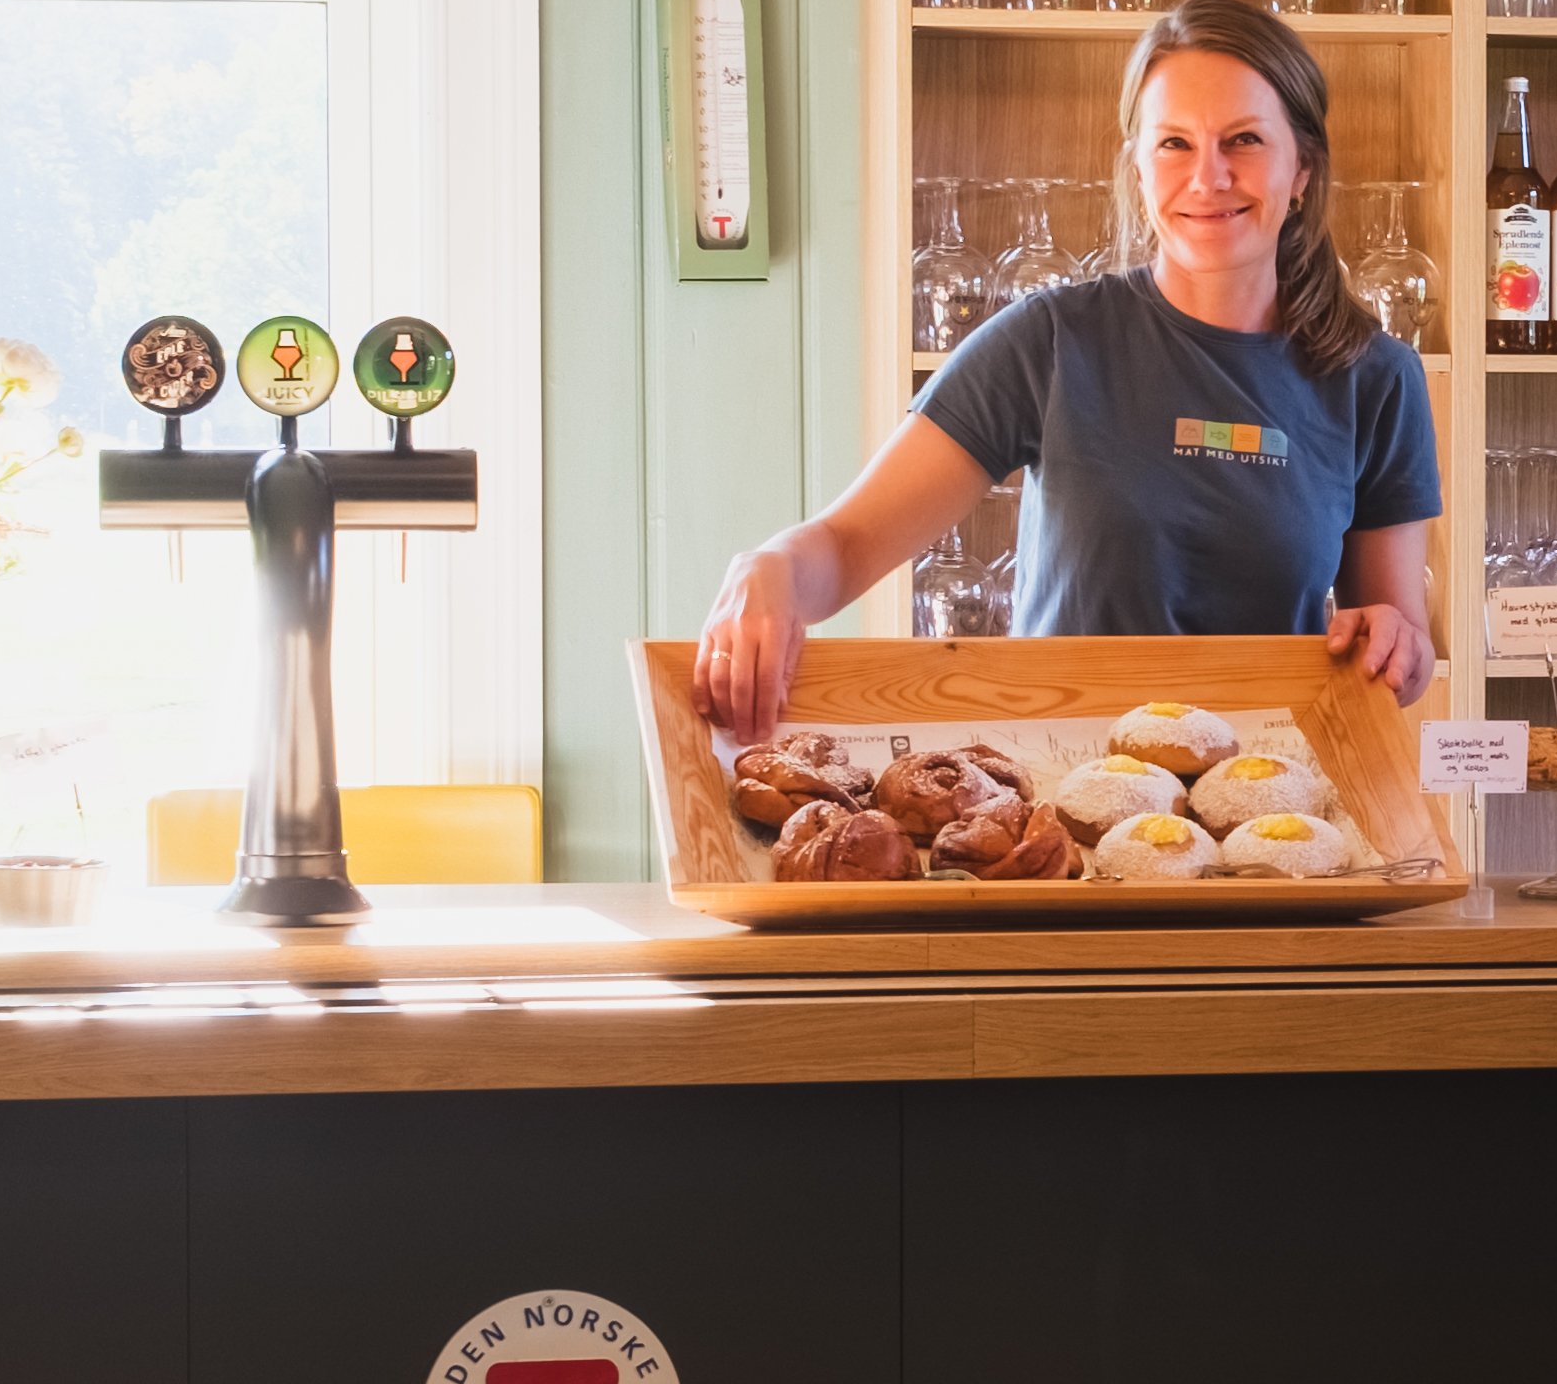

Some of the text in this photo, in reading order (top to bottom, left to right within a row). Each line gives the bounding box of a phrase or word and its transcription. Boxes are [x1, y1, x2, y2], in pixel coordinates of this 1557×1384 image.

[1493, 229, 1544, 240] Sprudlende
[1499, 239, 1541, 250] Eplemost
[265, 386, 316, 400] JUICY
[1173, 447, 1289, 468] MAT MED UTSIKT
[1510, 616, 1529, 625] med
[524, 1303, 659, 1379] NORSKE
